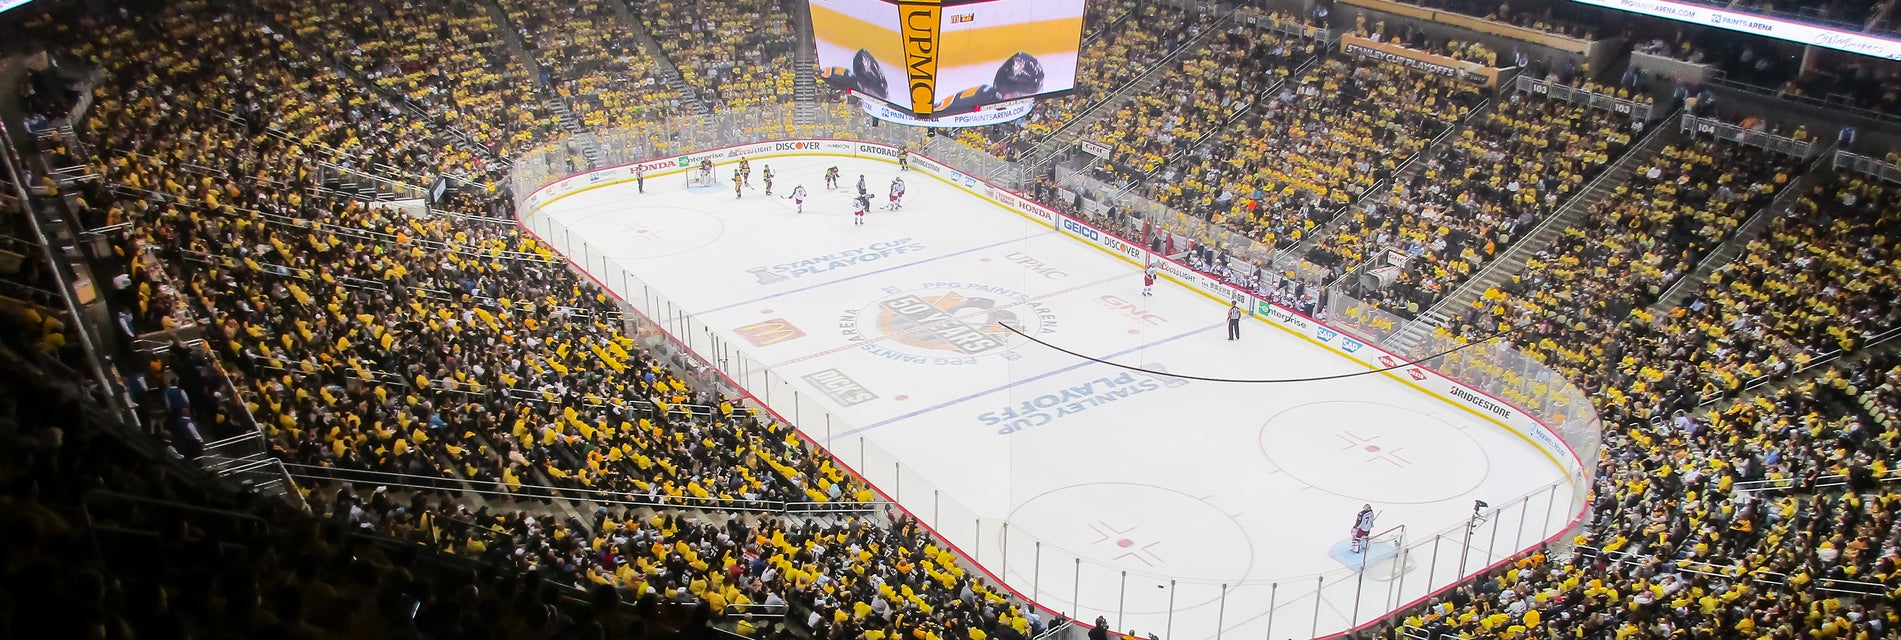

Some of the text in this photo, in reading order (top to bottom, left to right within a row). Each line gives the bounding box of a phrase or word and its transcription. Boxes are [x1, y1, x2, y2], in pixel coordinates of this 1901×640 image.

[1722, 16, 1747, 27] PAINTS
[1748, 22, 1773, 32] ARENA
[908, 10, 934, 104] UPMC
[1346, 44, 1386, 60] STANLEY
[1386, 54, 1405, 65] CUP
[1405, 59, 1454, 76] PLAYOFFS
[1533, 84, 1547, 94] 103
[1615, 104, 1630, 114] 103
[1698, 124, 1714, 134] 104
[776, 142, 820, 151] DISCOVER
[860, 145, 900, 158] GATORAD
[630, 160, 676, 174] HONDA
[1018, 201, 1052, 220] HONDA
[1064, 219, 1099, 241] GEICO
[772, 237, 913, 273] STANLEY CUP
[1104, 236, 1140, 259] DISCOVER
[789, 242, 927, 278] PLAYOFFS
[1005, 252, 1068, 280] UPMC
[1179, 271, 1196, 283] LIGHT
[922, 282, 1058, 335] PPG PAINTS ARENA
[1100, 295, 1168, 327] GNC
[916, 312, 997, 352] YEARS
[1318, 329, 1333, 341] SAP
[1342, 340, 1358, 352] SAP
[977, 372, 1137, 426] PLAYOFFS
[997, 379, 1159, 435] STANLEY CUP
[1450, 386, 1511, 419] BRIDGESTONE
